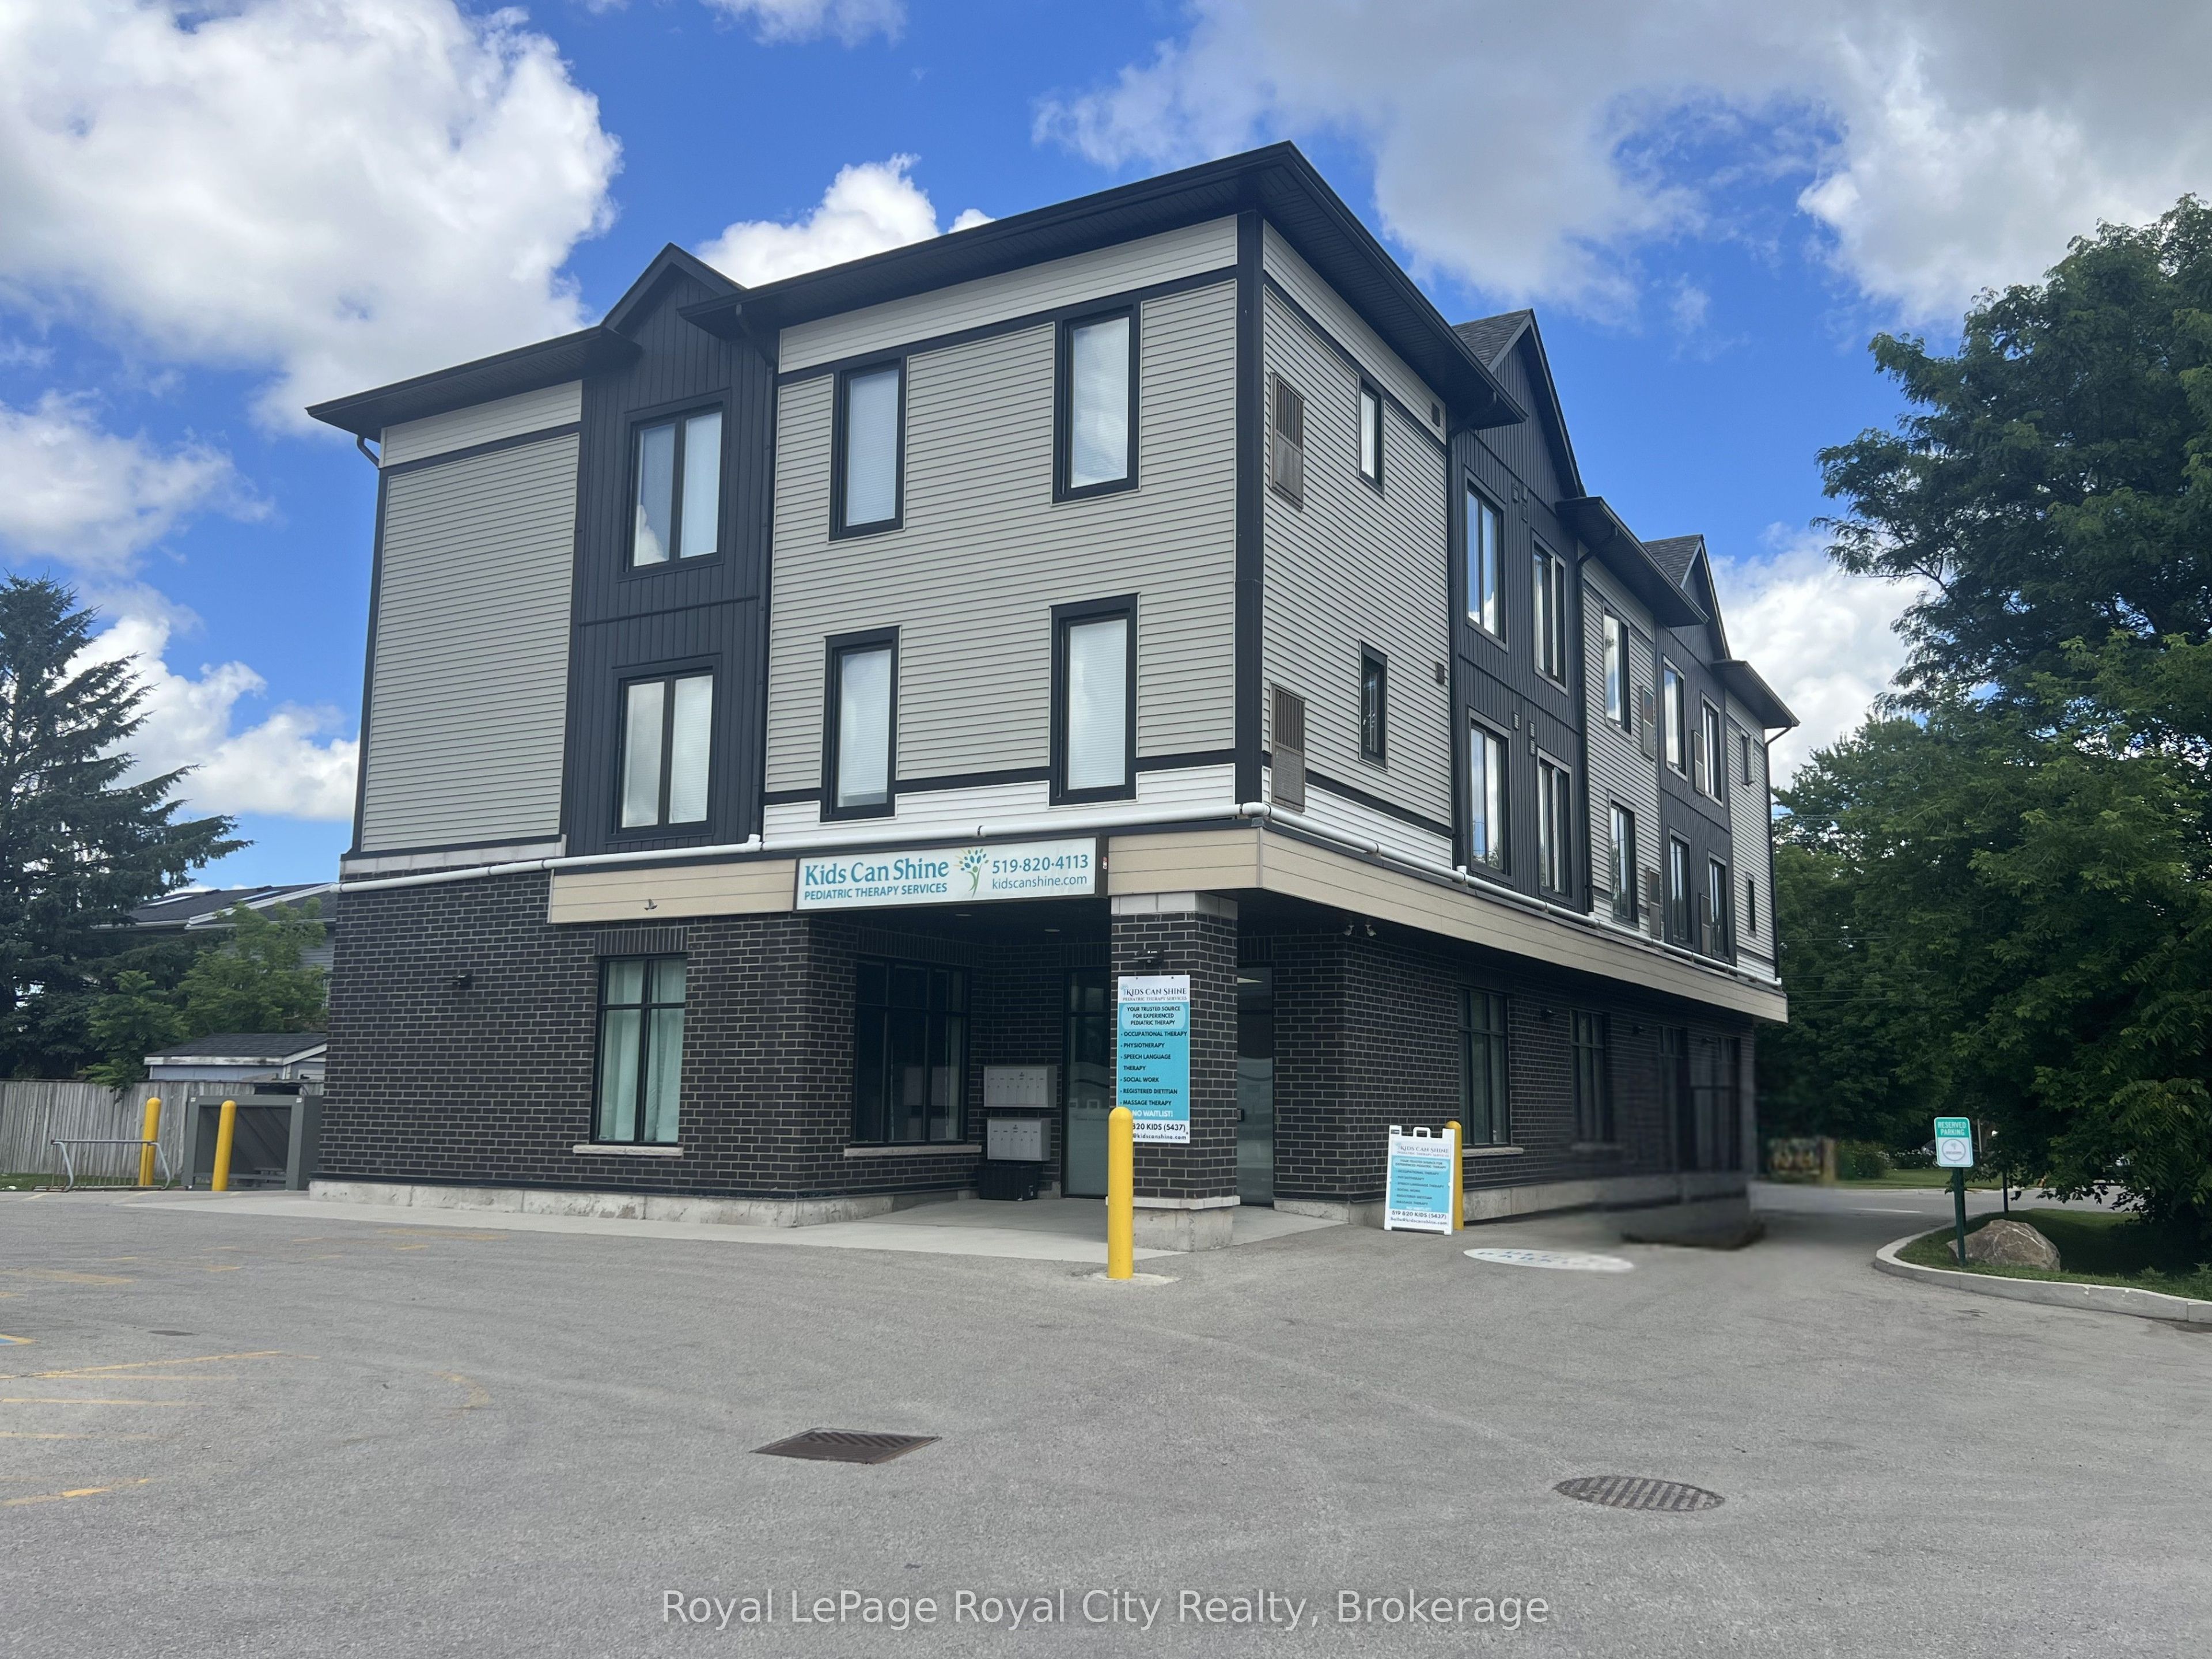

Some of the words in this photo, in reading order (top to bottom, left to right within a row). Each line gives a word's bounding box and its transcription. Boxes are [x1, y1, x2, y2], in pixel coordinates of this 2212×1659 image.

[805, 863, 846, 886] Kids
[851, 862, 889, 882] Can
[893, 858, 949, 880] Shine
[993, 876, 1087, 890] kidscanshine.com
[805, 888, 853, 900] PEDIATRIC
[855, 885, 899, 897] THERAPY
[902, 882, 947, 895] SERVICES
[1127, 988, 1143, 997] KIDS
[1164, 987, 1187, 995] SHINE
[1164, 1124, 1185, 1132] (5437)
